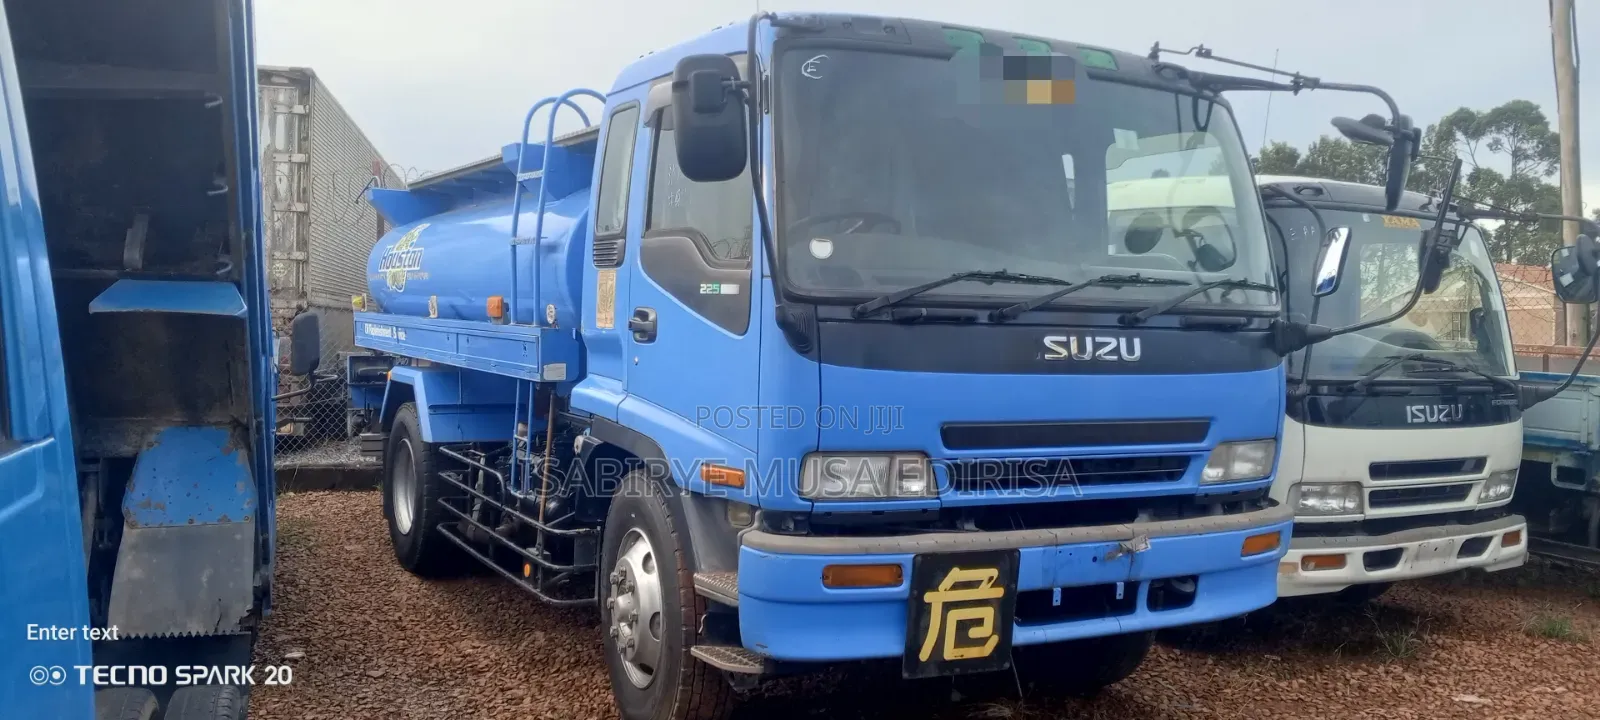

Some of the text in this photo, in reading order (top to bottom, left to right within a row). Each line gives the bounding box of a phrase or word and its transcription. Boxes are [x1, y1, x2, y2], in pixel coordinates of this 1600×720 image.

[380, 247, 423, 270] Houston
[700, 284, 720, 294] 225
[1405, 404, 1463, 423] ISUZU
[919, 566, 1004, 662] 危
